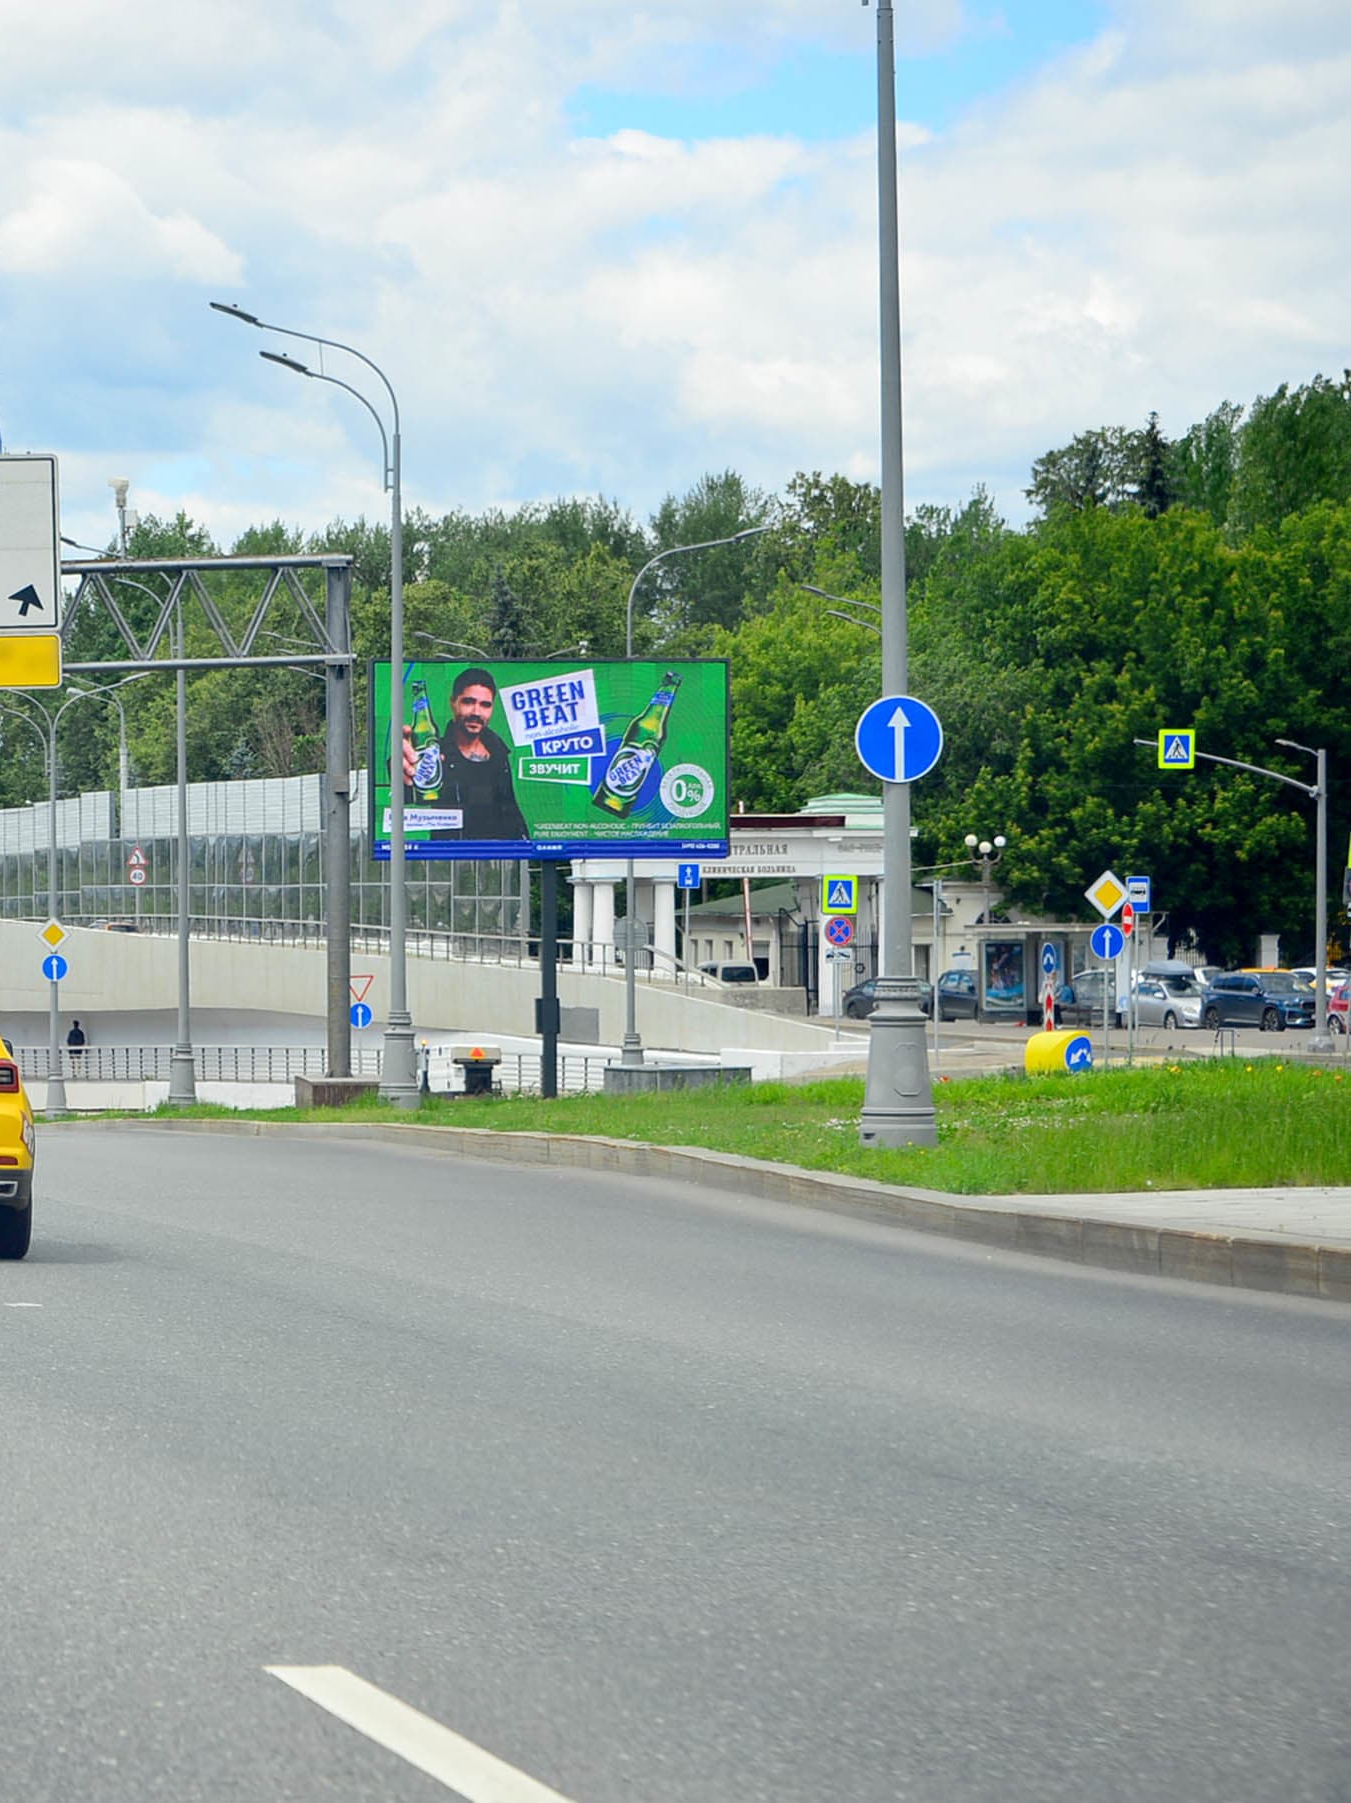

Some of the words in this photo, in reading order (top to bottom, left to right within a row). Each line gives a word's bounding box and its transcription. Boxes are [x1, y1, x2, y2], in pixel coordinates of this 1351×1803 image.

[511, 680, 585, 711] GREEN
[522, 702, 579, 730] BEAT
[541, 736, 594, 755] КРУТО
[529, 763, 581, 775] ЗВУЧИТ
[730, 844, 789, 856] ТРАЛЬНАЯ
